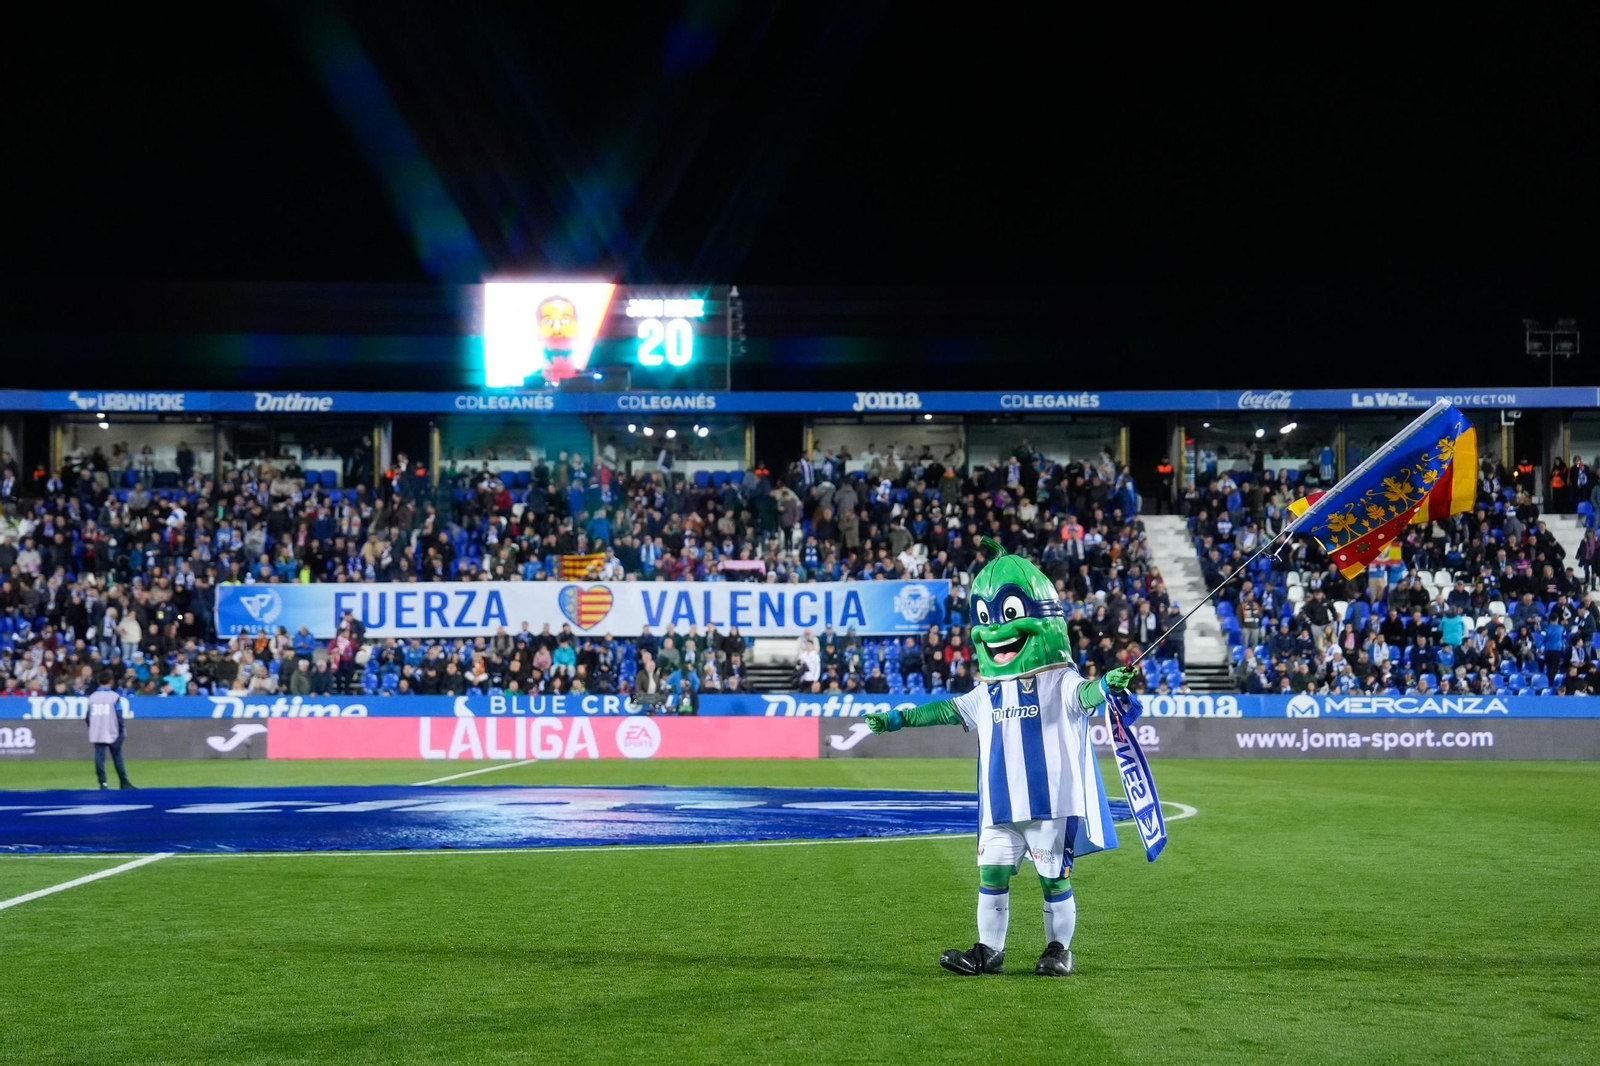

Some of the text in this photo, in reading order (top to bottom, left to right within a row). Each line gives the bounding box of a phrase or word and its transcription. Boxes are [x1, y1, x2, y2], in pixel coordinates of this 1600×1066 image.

[637, 318, 693, 367] 20
[97, 393, 185, 411] URBAN POKE
[254, 392, 334, 411] Ontime
[1352, 393, 1374, 407] La
[336, 590, 509, 628] FUERZA
[641, 590, 867, 628] VALENCIA
[490, 696, 566, 714] BLUE
[1325, 697, 1508, 714] MERCANZA
[419, 716, 599, 759] LALIGA
[625, 725, 652, 740] EA
[1236, 728, 1494, 751] www.joma-sport.com
